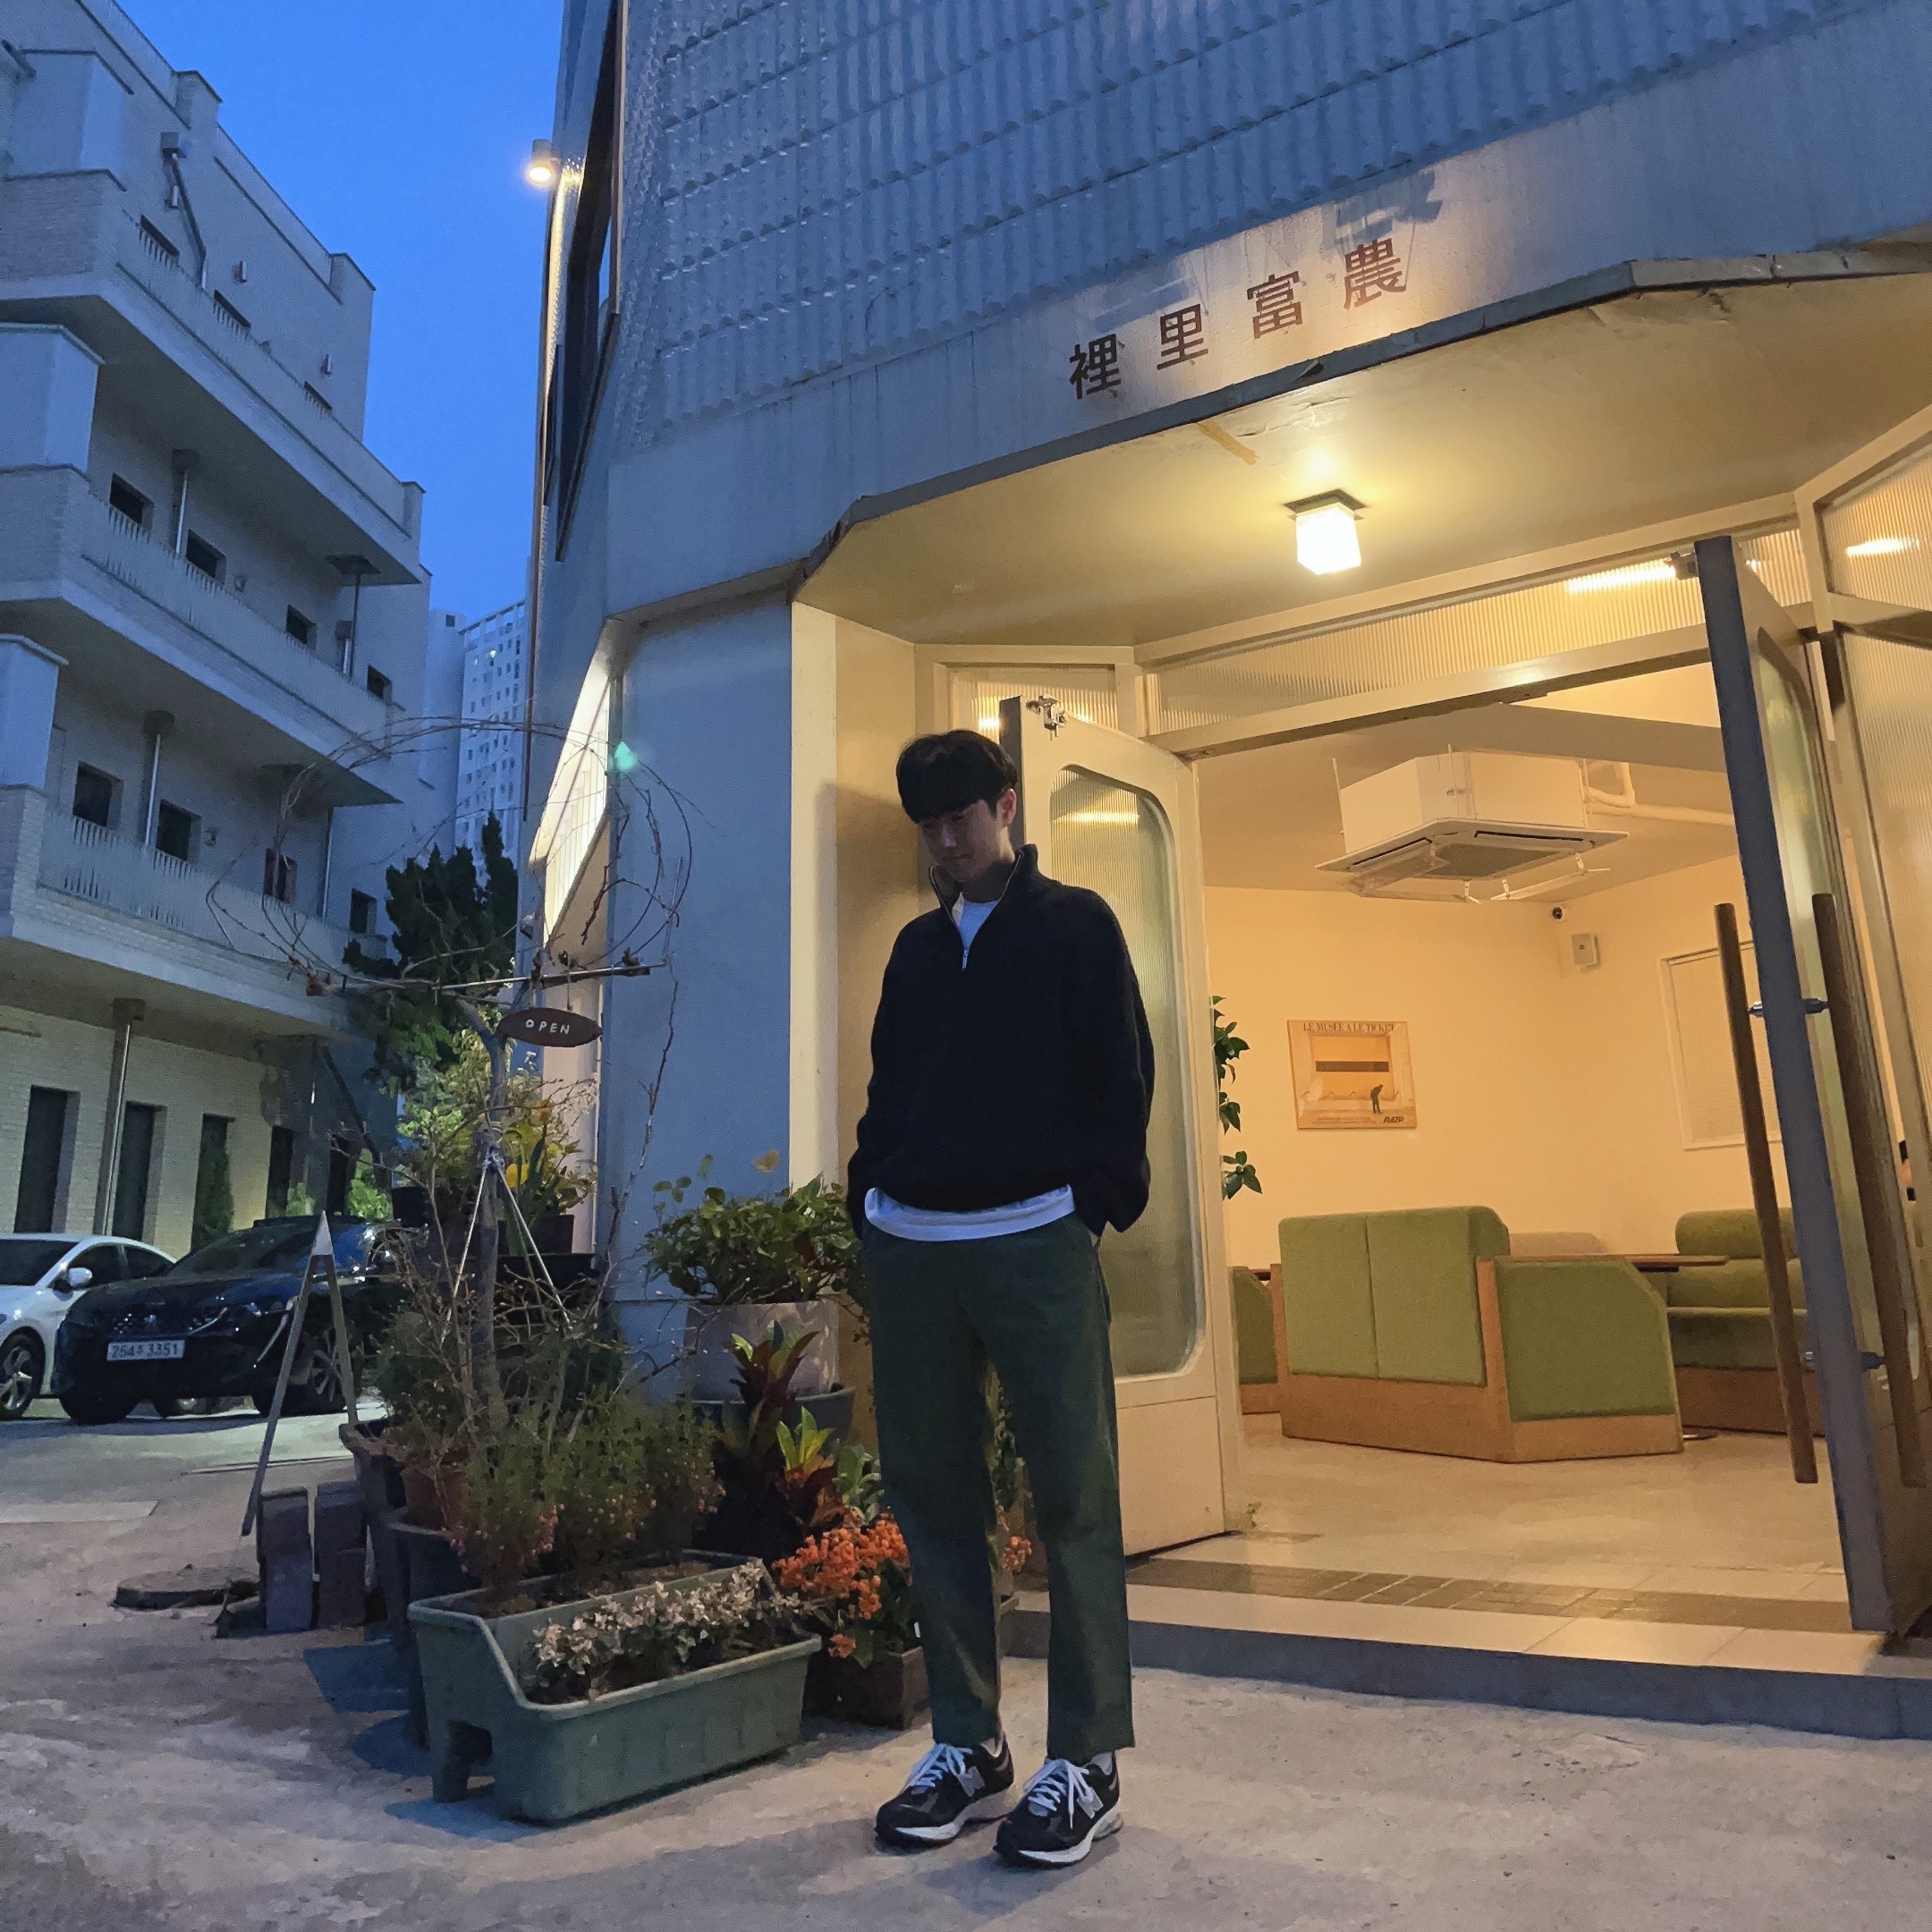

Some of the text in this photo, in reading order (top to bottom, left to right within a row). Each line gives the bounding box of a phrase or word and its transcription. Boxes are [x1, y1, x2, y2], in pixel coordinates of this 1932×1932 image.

[1069, 238, 1406, 400] 裡里富農
[526, 1019, 570, 1034] OPEN
[1303, 1022, 1315, 1031] LE
[1366, 1023, 1394, 1032] TICKET
